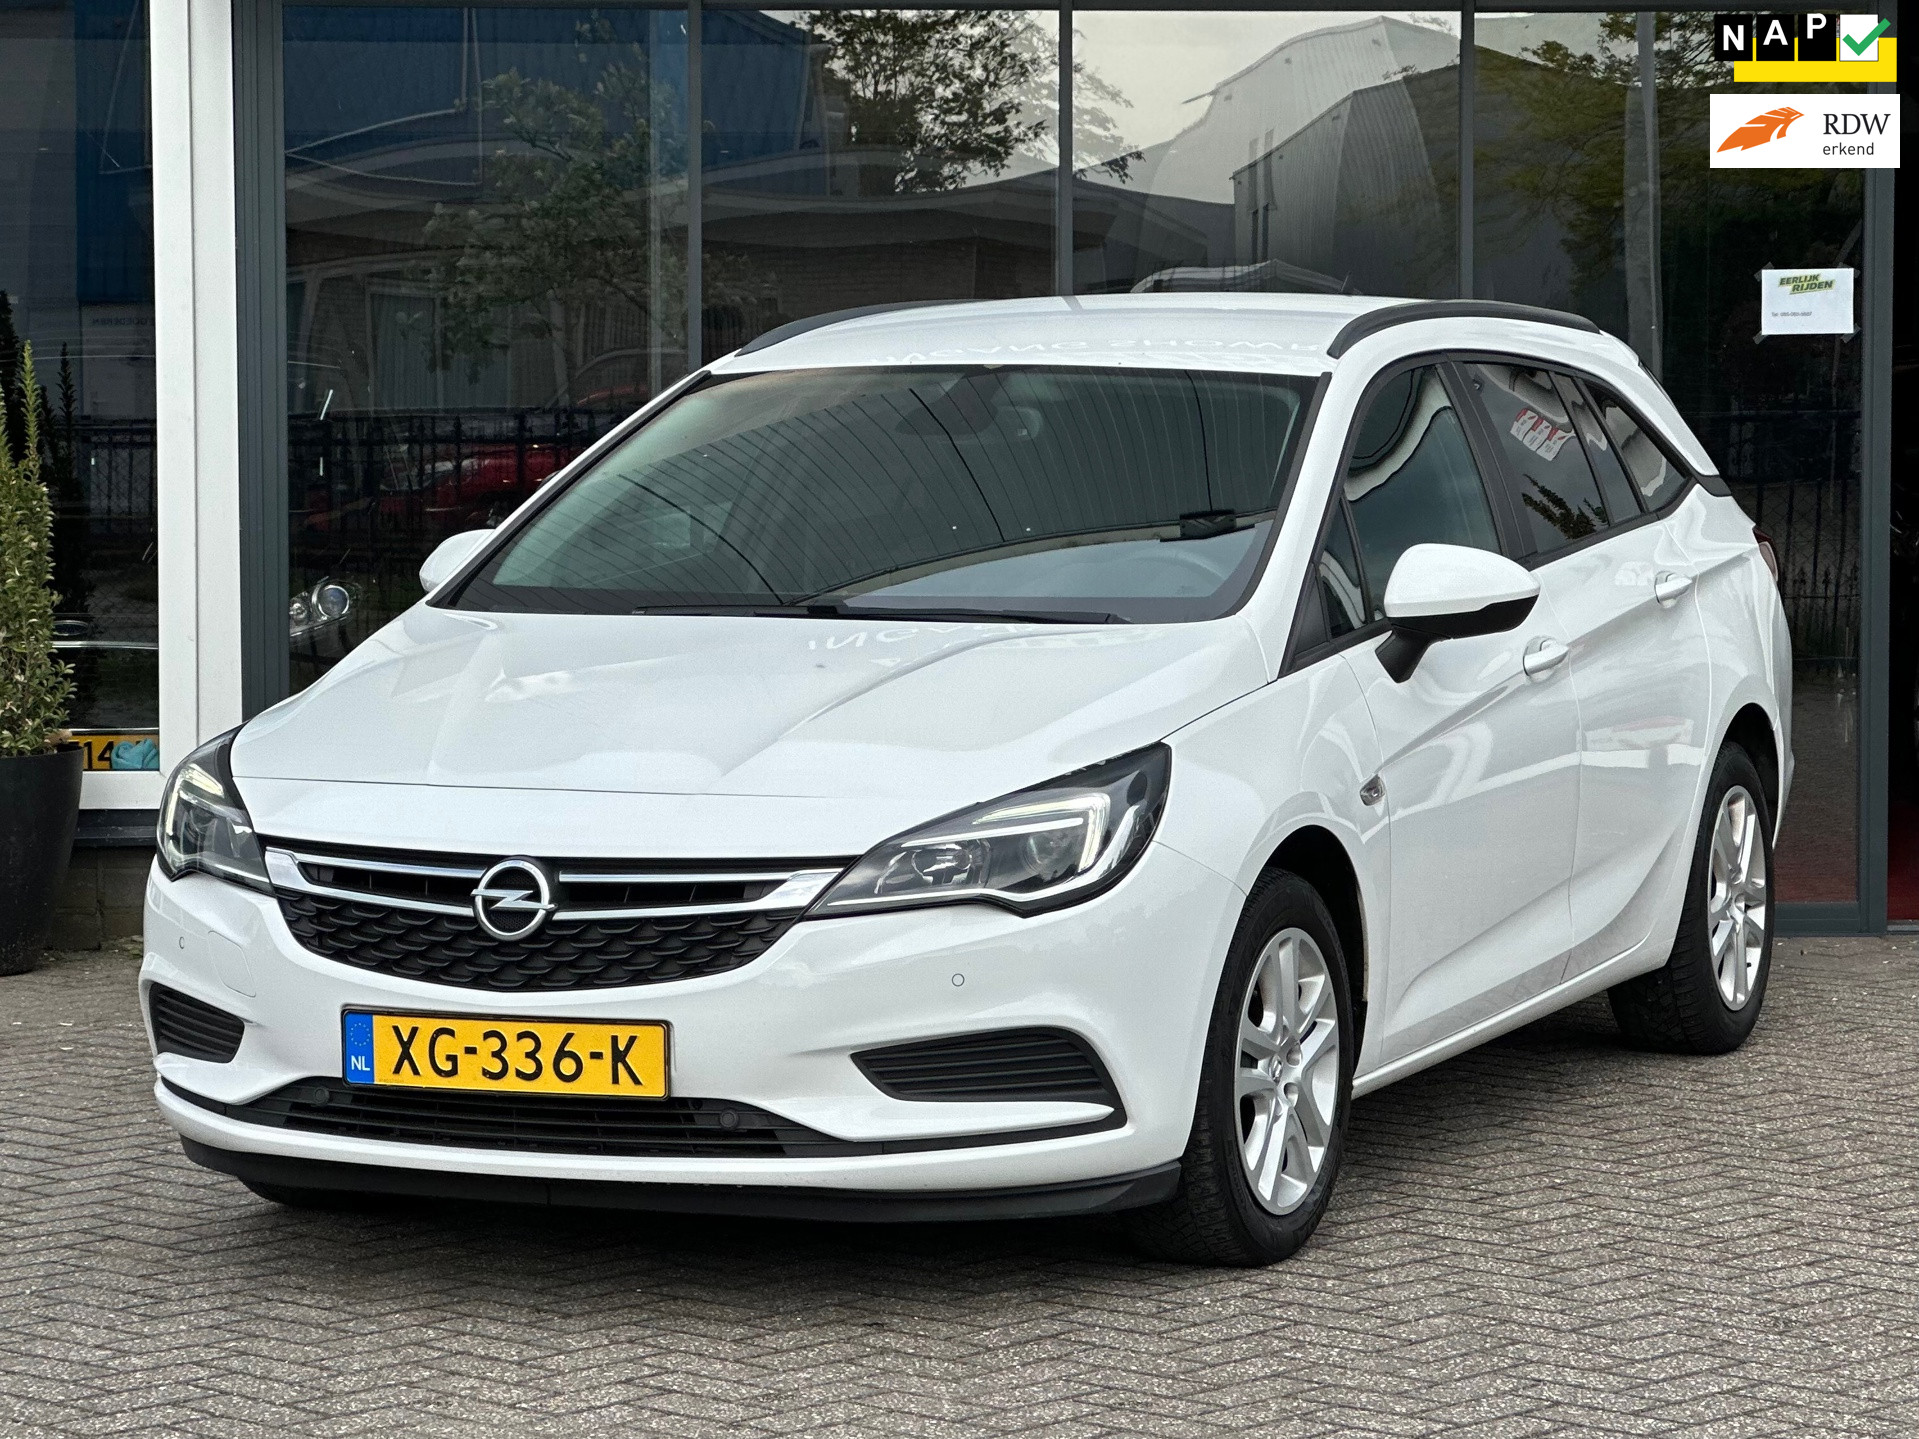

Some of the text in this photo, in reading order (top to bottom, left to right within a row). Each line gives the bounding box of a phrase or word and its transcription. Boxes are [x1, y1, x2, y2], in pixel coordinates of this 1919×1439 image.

[1779, 274, 1820, 286] EERLIJK
[1791, 280, 1834, 292] RIJDEN
[392, 1025, 643, 1086] XG-336-K
[351, 1055, 370, 1071] NL
